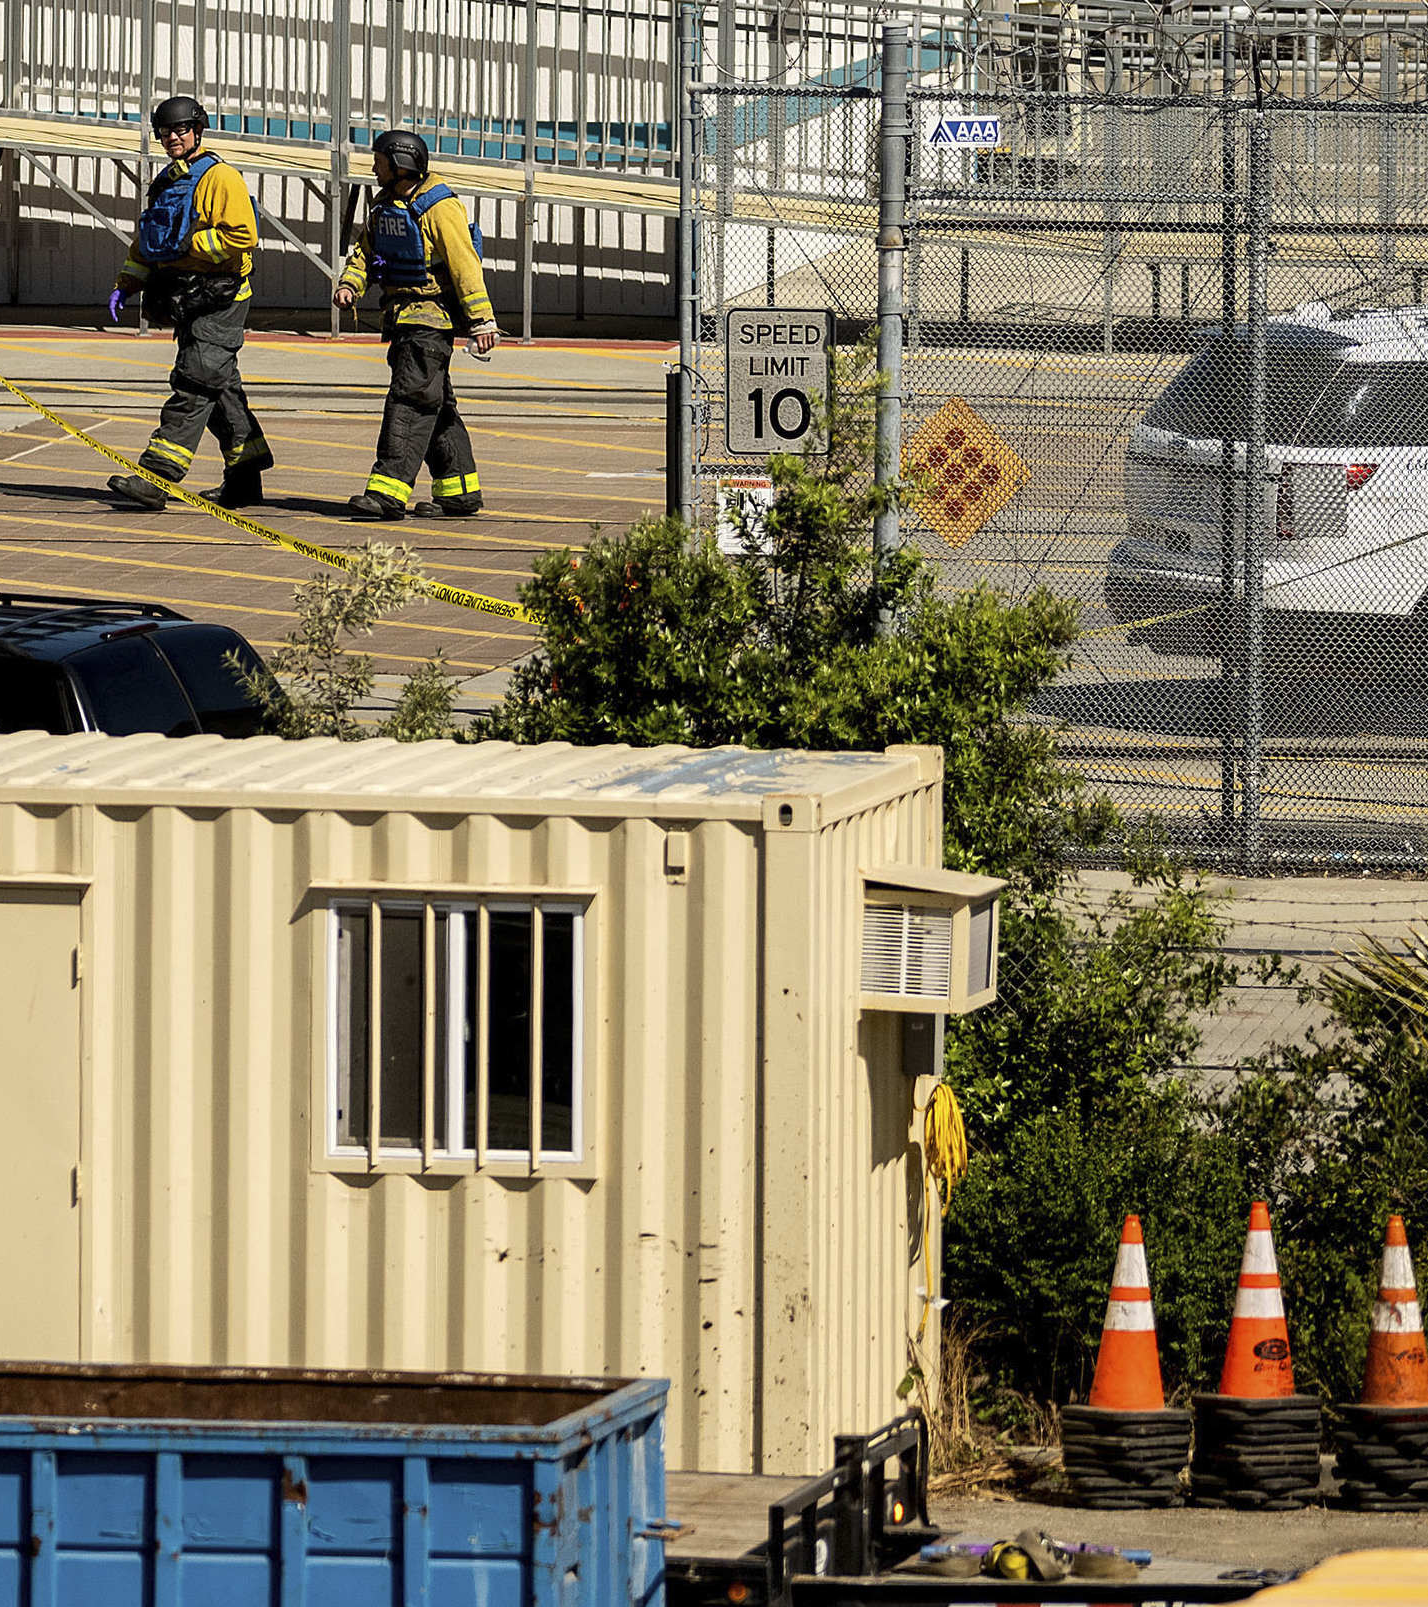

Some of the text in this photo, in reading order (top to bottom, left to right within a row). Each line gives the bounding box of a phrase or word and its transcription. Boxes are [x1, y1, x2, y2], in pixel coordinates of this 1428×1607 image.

[956, 122, 997, 137] AAA
[379, 216, 407, 236] FIRE
[739, 324, 821, 344] SPEED
[749, 356, 810, 376] LIMIT
[748, 387, 811, 440] 10
[435, 588, 453, 603] NOT
[451, 592, 465, 607] DO
[463, 595, 483, 610] LINE
